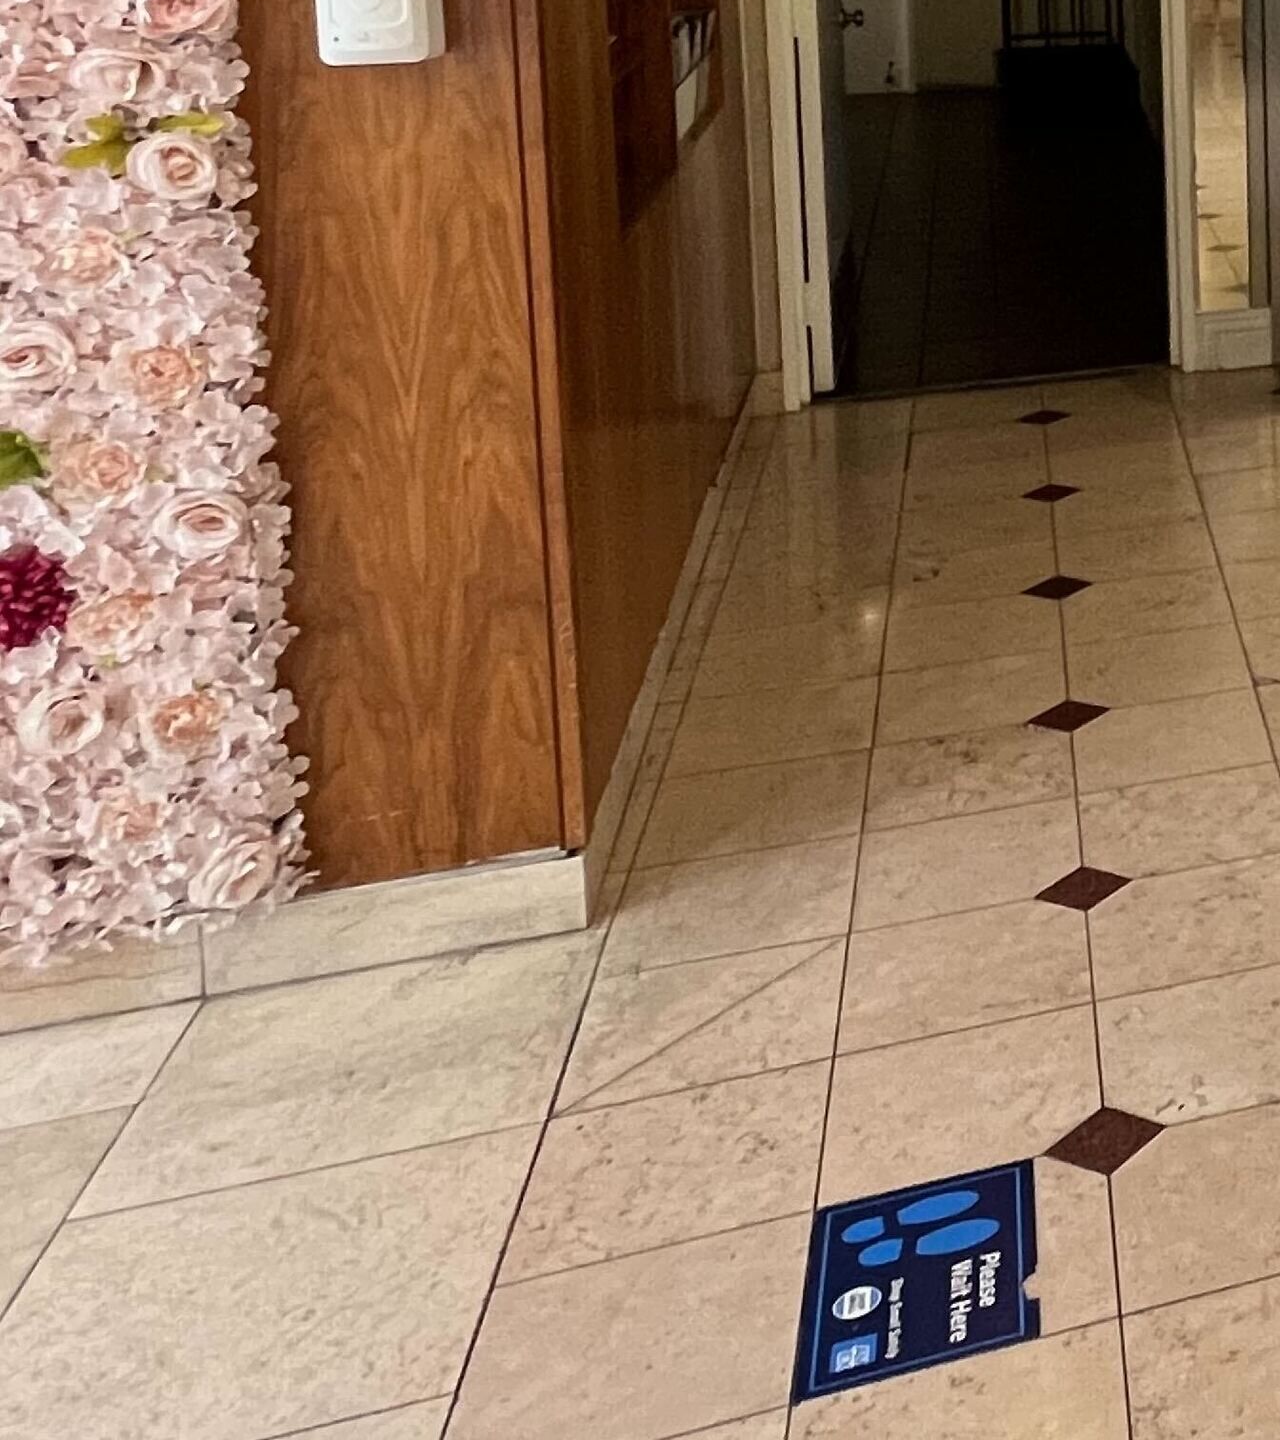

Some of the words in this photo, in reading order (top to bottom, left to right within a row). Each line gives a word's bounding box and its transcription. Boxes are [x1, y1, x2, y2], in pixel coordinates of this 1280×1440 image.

[951, 1259, 973, 1299] Wait
[979, 1250, 1001, 1308] Please
[950, 1301, 972, 1343] Here
